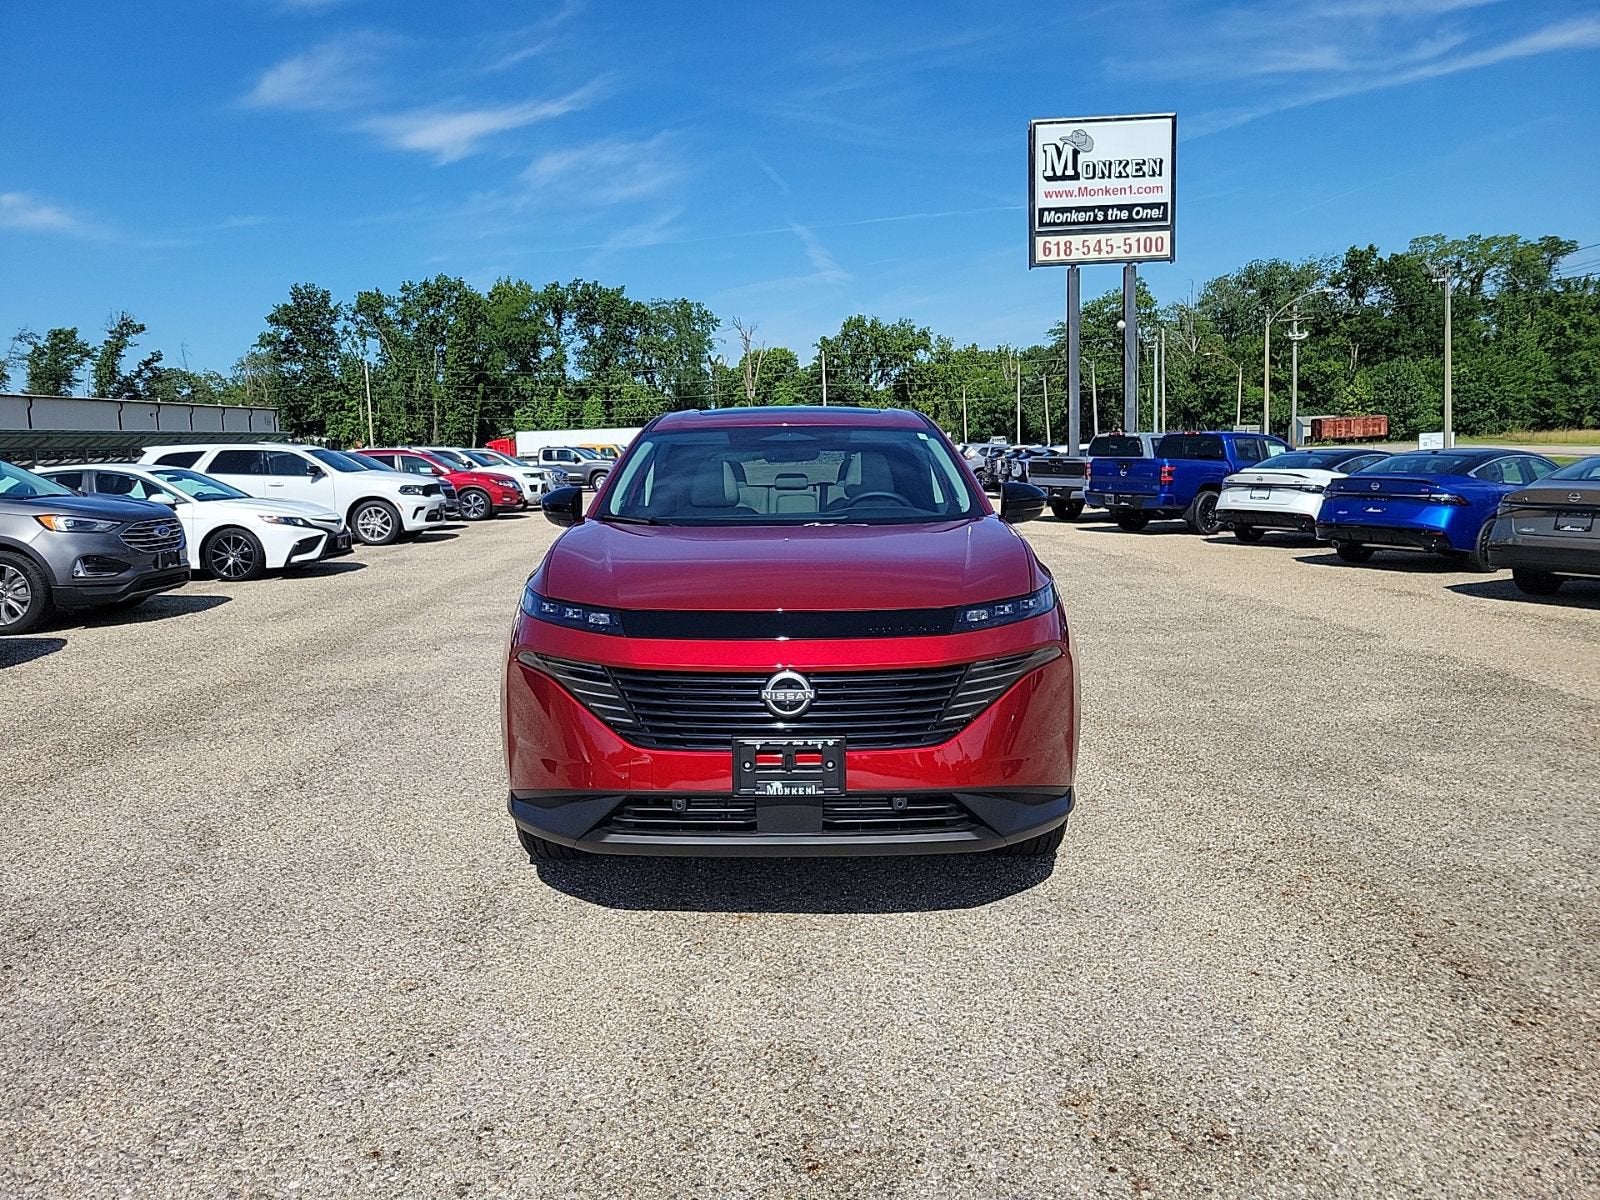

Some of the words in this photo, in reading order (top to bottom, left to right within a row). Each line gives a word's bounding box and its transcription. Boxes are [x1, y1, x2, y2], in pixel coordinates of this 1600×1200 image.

[1043, 143, 1163, 182] MONKEN
[1043, 185, 1163, 199] www.Monken1.com
[1042, 209, 1104, 224] Monken's
[1107, 207, 1129, 220] the
[1132, 205, 1164, 219] One!
[1042, 236, 1164, 257] 618-545-5100
[761, 690, 815, 700] NISSAN
